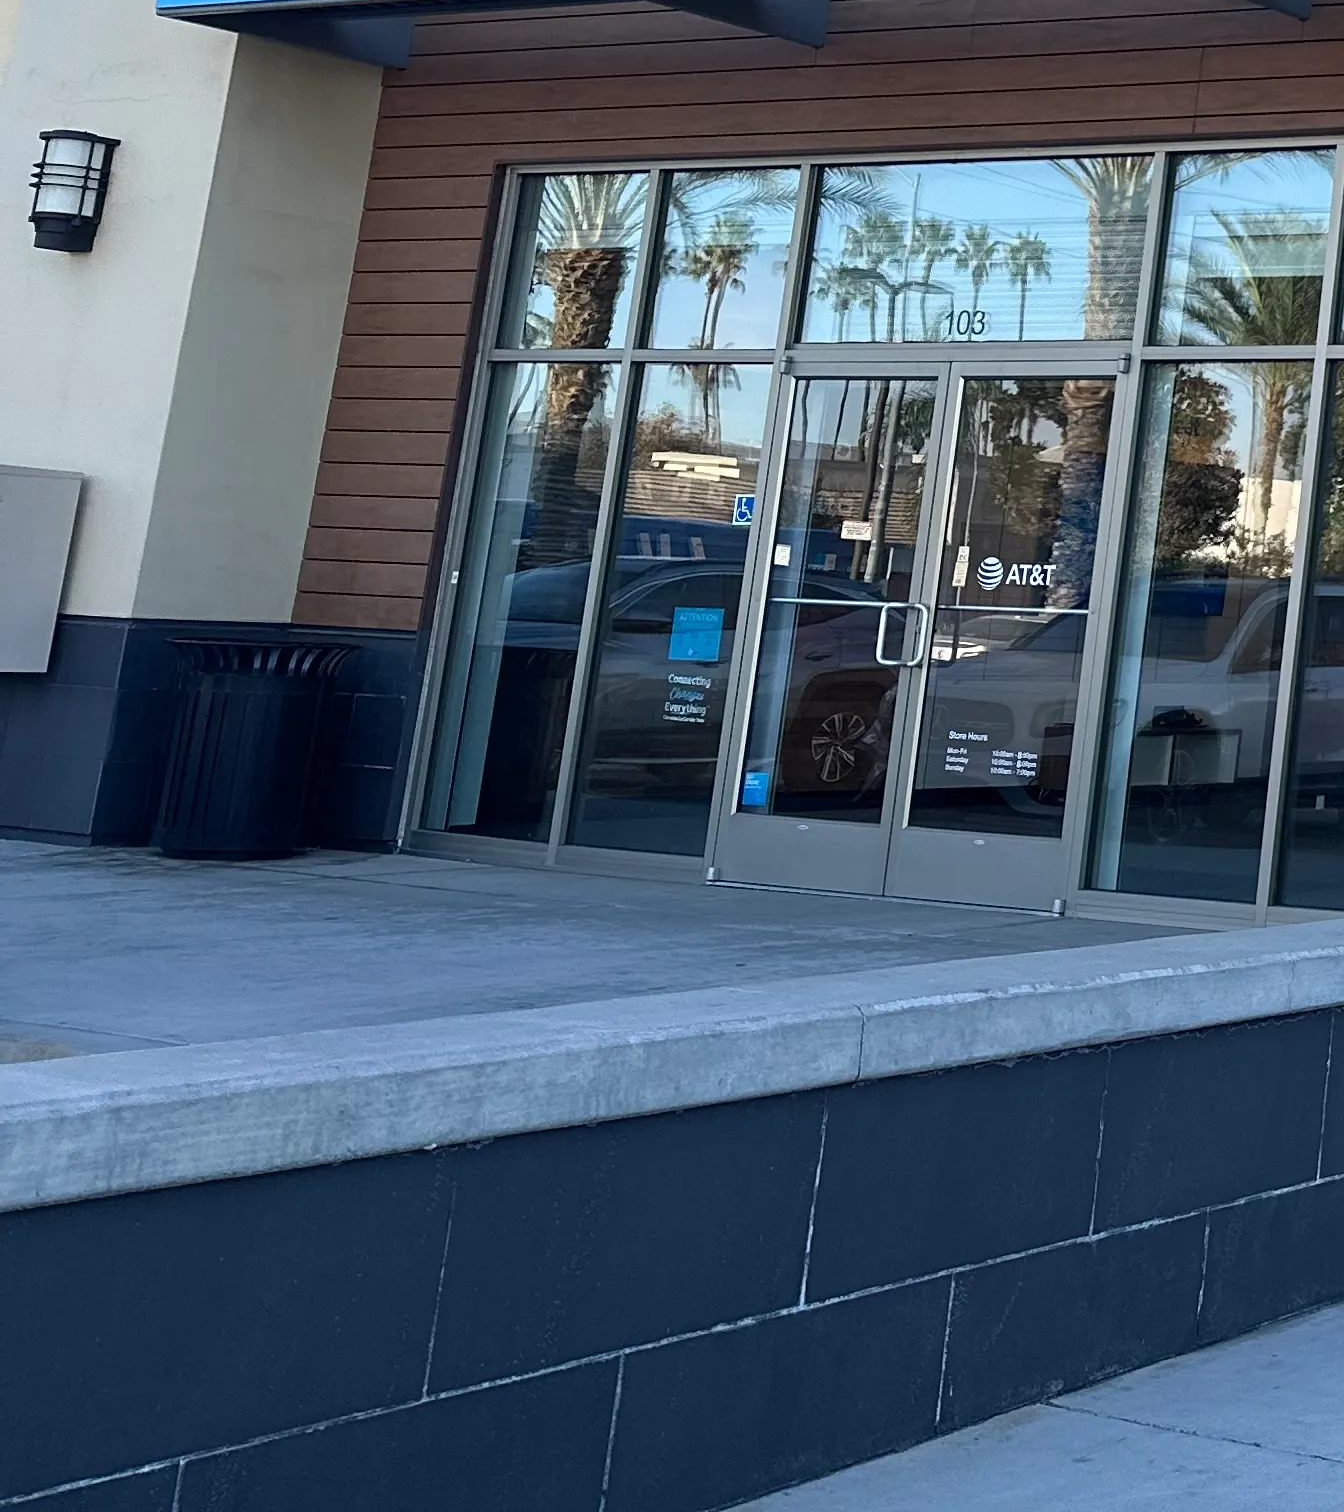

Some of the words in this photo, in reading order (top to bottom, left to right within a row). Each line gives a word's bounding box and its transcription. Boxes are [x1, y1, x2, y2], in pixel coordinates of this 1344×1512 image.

[945, 309, 986, 336] 103
[1005, 563, 1057, 586] AT&T
[948, 730, 967, 740] Store
